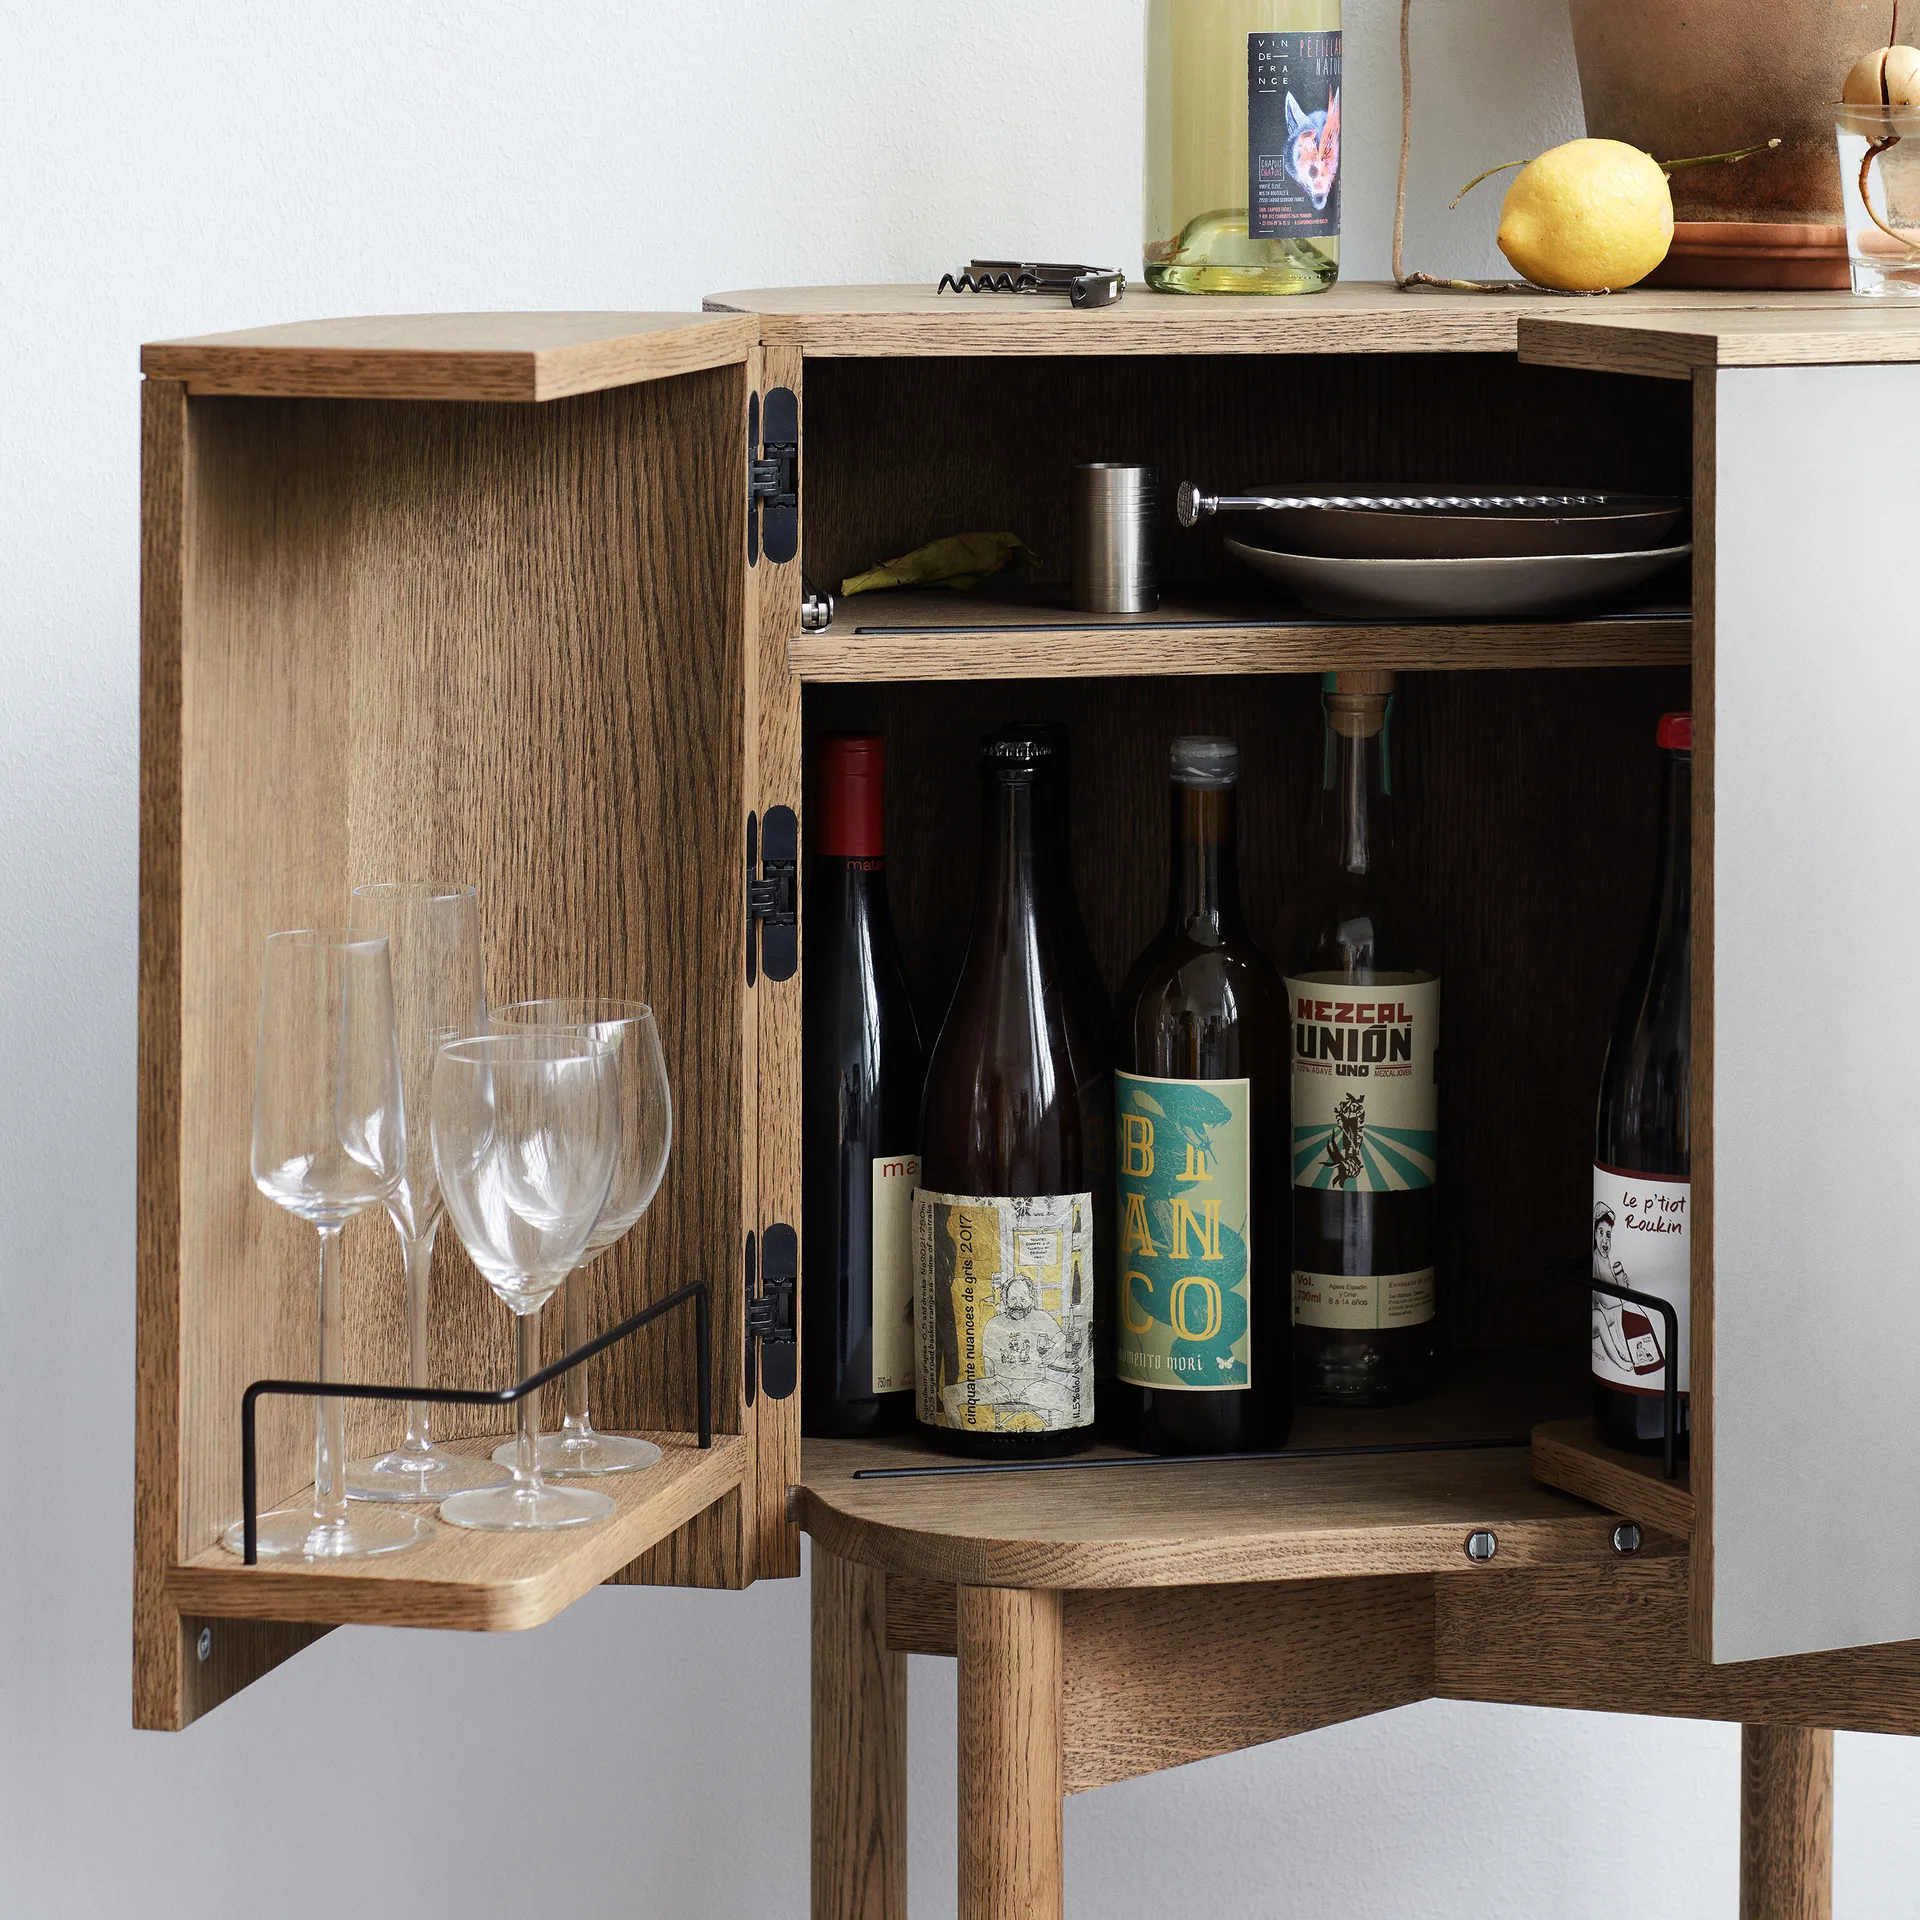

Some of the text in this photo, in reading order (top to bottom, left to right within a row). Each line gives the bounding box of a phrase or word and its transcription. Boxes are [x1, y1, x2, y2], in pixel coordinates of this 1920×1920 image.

[1299, 36, 1341, 58] PÉTILLA
[1258, 65, 1288, 73] FRA
[1315, 57, 1341, 75] NATU
[1258, 77, 1288, 85] NCE
[1298, 998, 1413, 1024] MEZCAL
[1296, 1023, 1412, 1063] UNIÓN
[1311, 1066, 1333, 1075] AGAVE
[1335, 1063, 1369, 1077] UNO
[1374, 1069, 1412, 1077] MEZCAL JOVEN
[1622, 1191, 1687, 1214] Le p'tiot
[1624, 1214, 1683, 1234] Roukin
[928, 1295, 936, 1321] range
[960, 1214, 981, 1425] cinquante nuances de gris 2017
